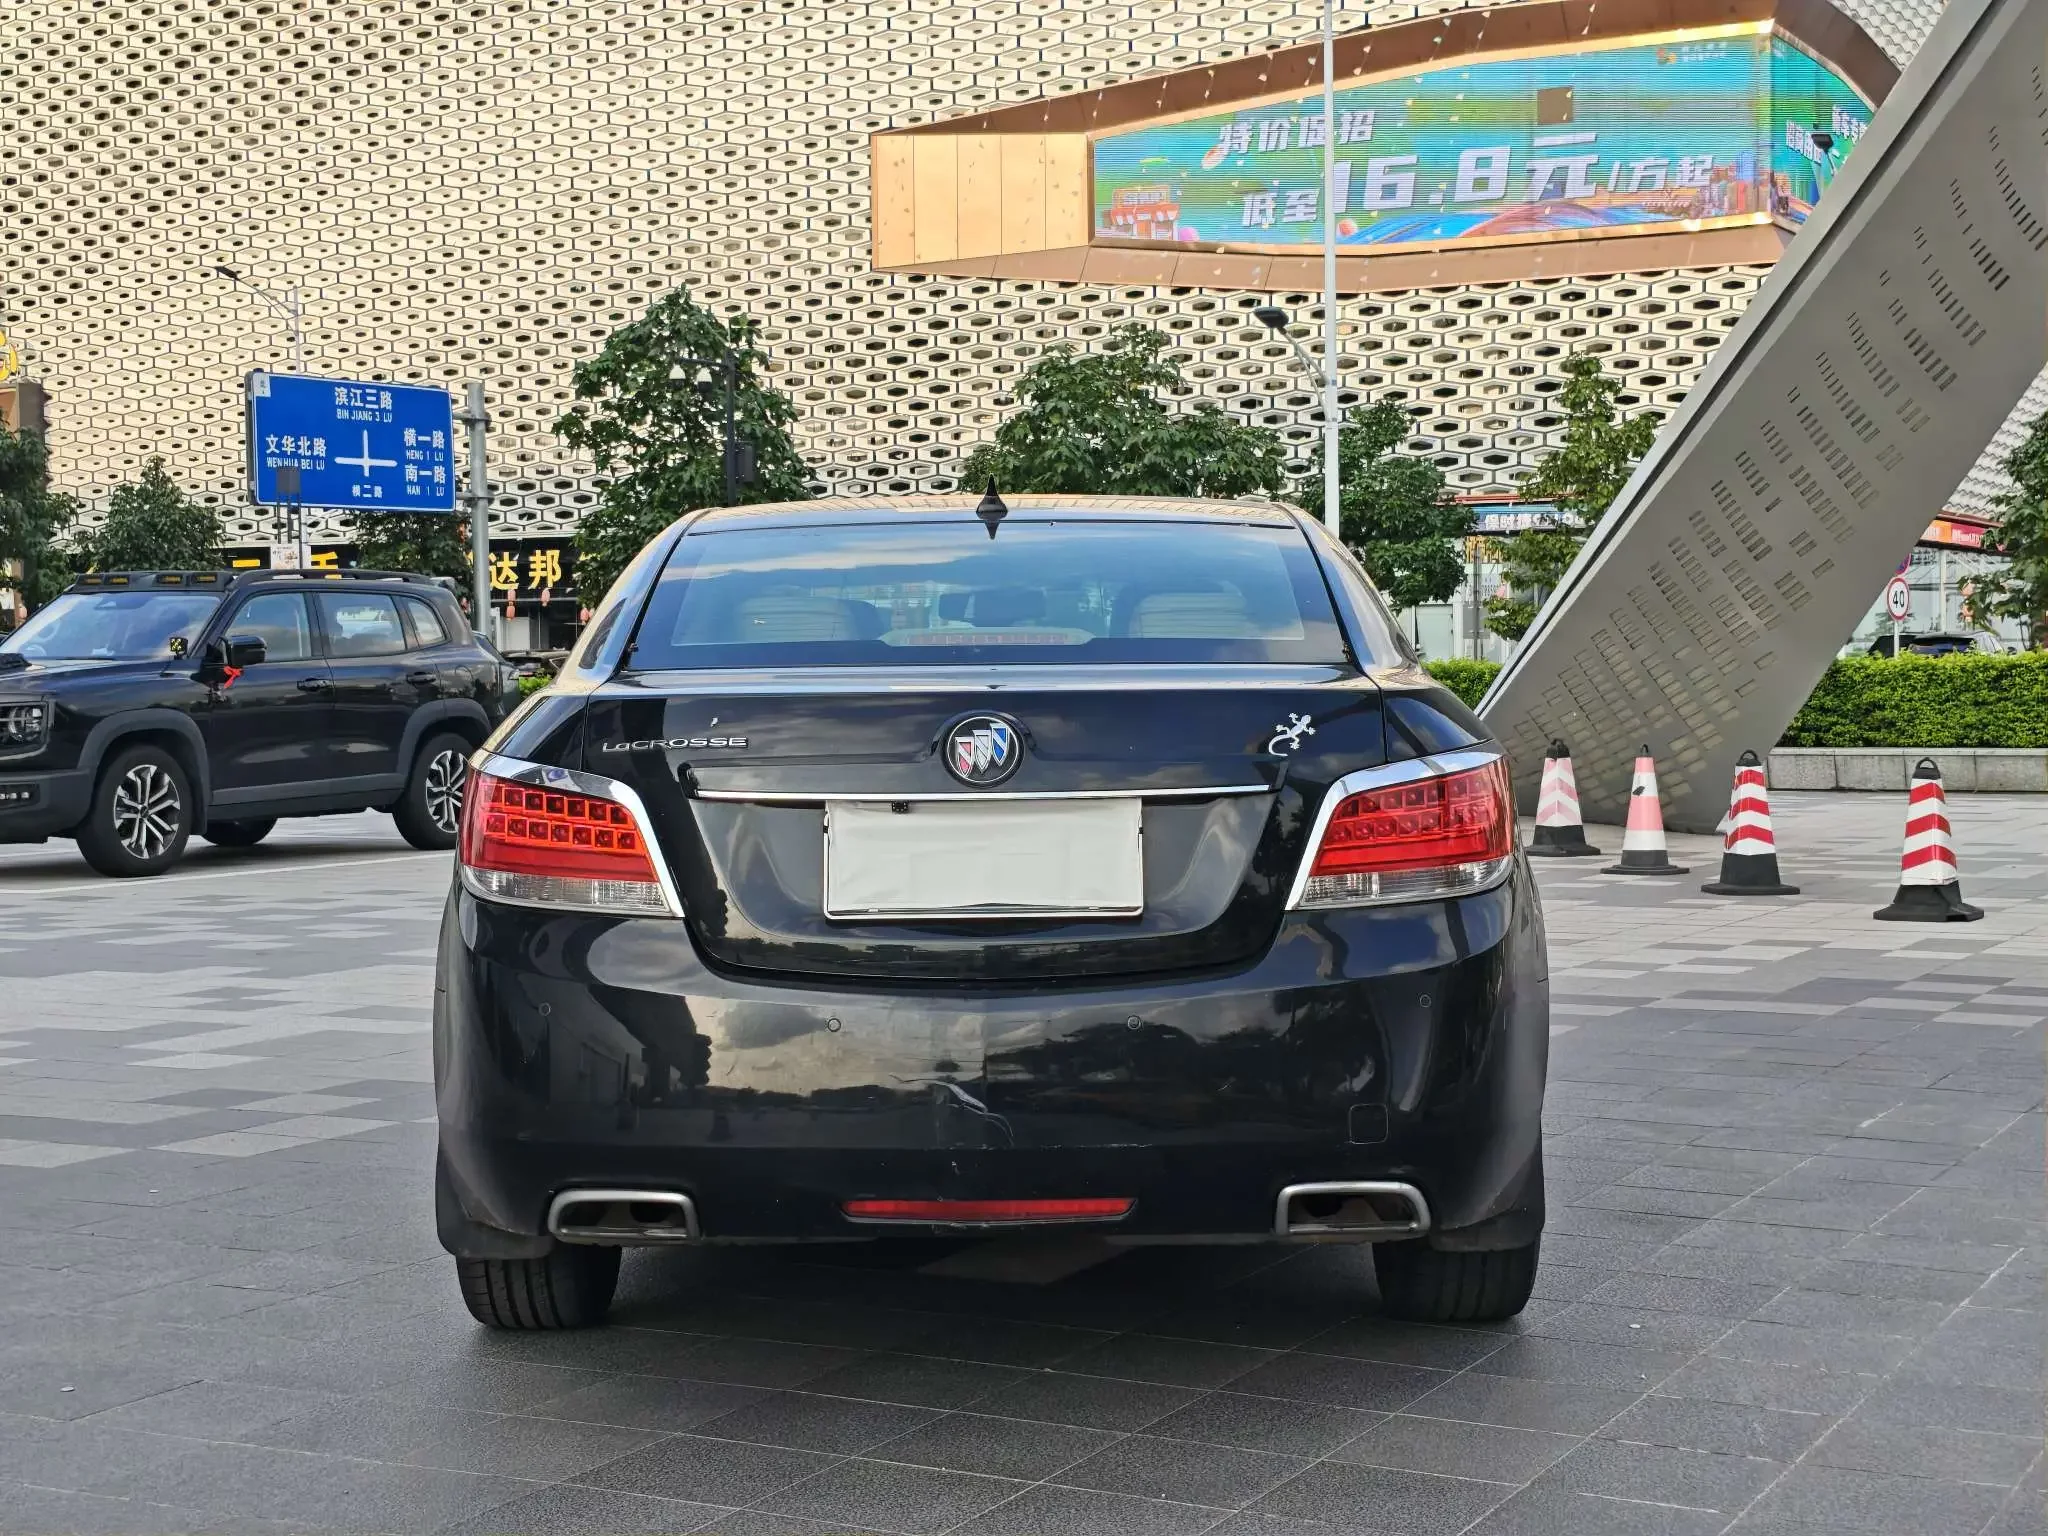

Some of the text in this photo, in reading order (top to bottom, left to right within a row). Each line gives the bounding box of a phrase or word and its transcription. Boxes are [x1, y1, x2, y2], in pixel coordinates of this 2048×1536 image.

[334, 386, 393, 410] 滨江三路
[351, 410, 373, 422] JIANG
[375, 411, 380, 422] 3
[383, 412, 392, 423] LU
[265, 434, 327, 458] 文华北路
[403, 427, 445, 449] 横一路
[301, 458, 313, 470] BEI
[316, 460, 325, 471] LU
[405, 450, 424, 461] HENG
[434, 451, 444, 462] LU
[404, 463, 447, 484] 南一路
[436, 486, 445, 497] LU
[1893, 590, 1905, 608] 40
